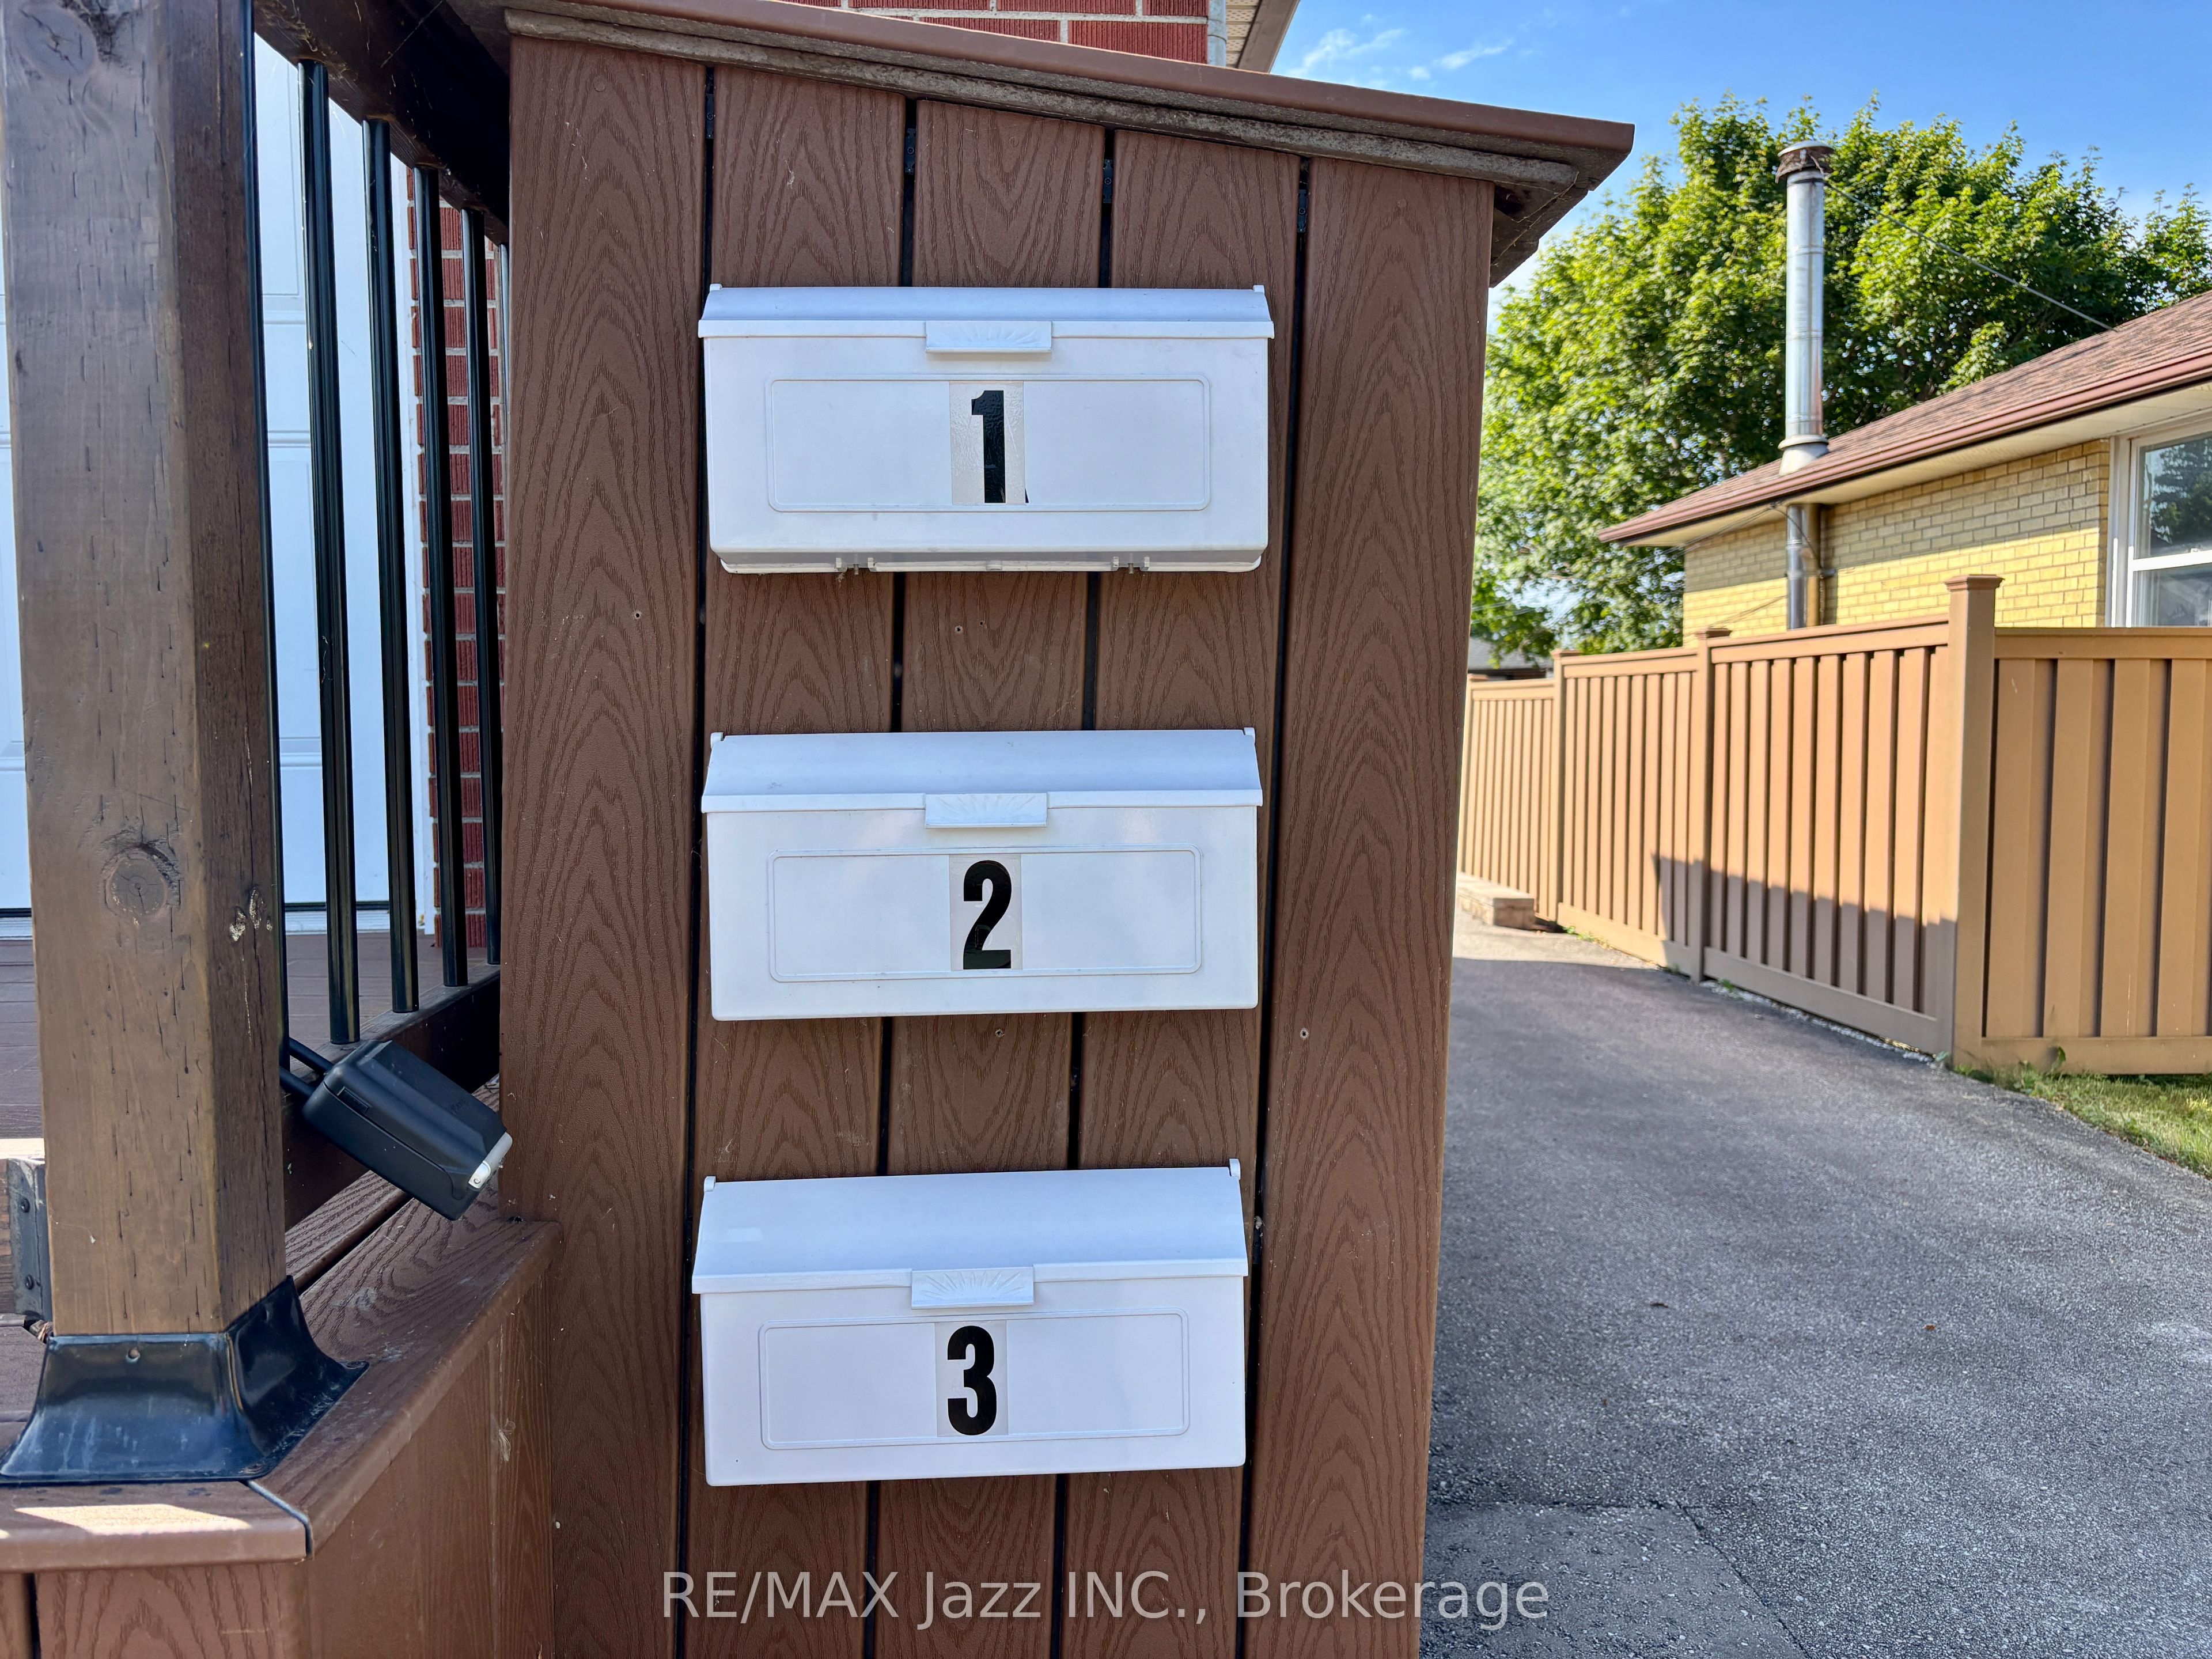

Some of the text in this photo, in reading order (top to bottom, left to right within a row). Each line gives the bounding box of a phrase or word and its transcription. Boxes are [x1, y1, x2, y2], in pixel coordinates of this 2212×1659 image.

[972, 391, 1006, 503] 1
[963, 859, 1012, 970] 2
[947, 1325, 997, 1436] 3
